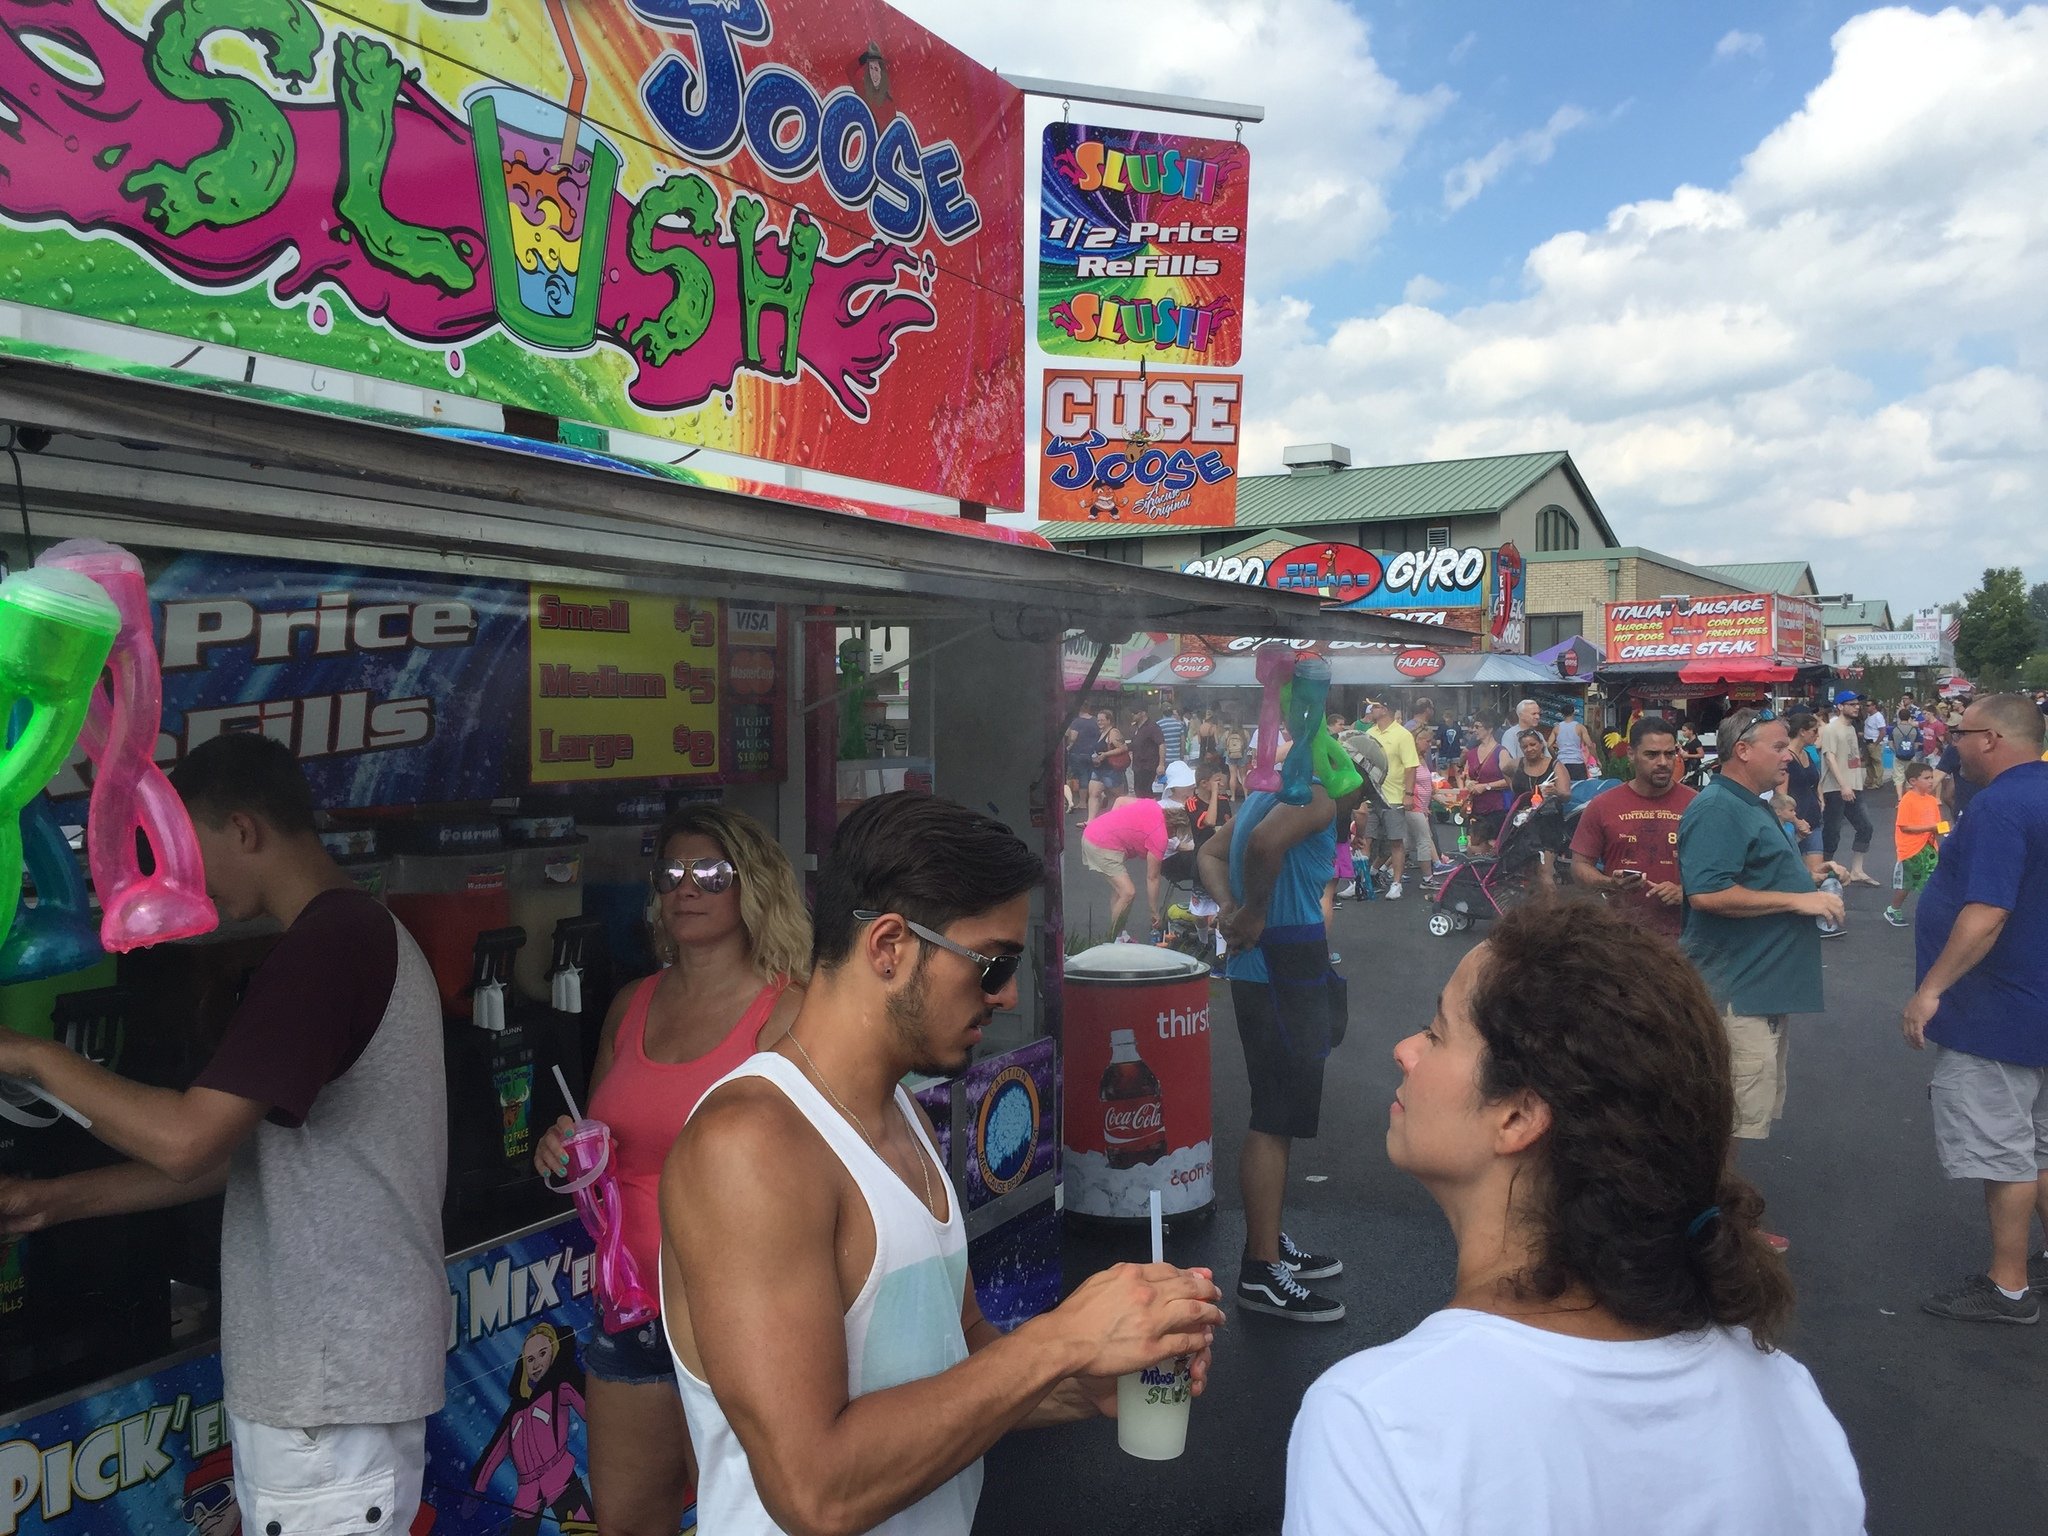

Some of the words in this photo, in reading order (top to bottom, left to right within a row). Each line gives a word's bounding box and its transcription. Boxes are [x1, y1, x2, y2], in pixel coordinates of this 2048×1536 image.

[1075, 141, 1219, 205] SLUSH
[1049, 217, 1117, 249] 1/2
[1128, 221, 1240, 244] Price
[1076, 254, 1221, 278] ReFills
[1070, 292, 1213, 352] SLUSH
[1045, 376, 1239, 445] CUSE
[1045, 430, 1234, 490] JOOSE
[1131, 488, 1181, 514] Syracuse
[1147, 492, 1191, 520] Original
[1385, 547, 1485, 592] GYRO
[160, 592, 477, 669] Price
[538, 594, 630, 633] Small
[673, 602, 715, 647] $3
[736, 611, 769, 631] VISA
[1615, 622, 1662, 632] BURGERS
[1707, 619, 1734, 627] CORN
[1737, 617, 1766, 625] DOGS
[1742, 627, 1769, 636] FRIES
[1613, 634, 1633, 642] HOT
[1636, 632, 1664, 641] DOGS
[1178, 656, 1206, 664] GYRO
[1620, 644, 1692, 659] CHEESE
[1695, 640, 1757, 655] STEAK
[731, 665, 775, 680] MasterCard
[1174, 664, 1210, 673] BOWLS
[1397, 657, 1440, 668] FALAFEL
[538, 663, 667, 699] Medium
[673, 660, 716, 704] $5
[735, 716, 771, 727] LIGHT
[745, 727, 762, 737] UP
[539, 728, 634, 769] Large
[673, 724, 715, 767] $8
[736, 738, 770, 749] MUGS
[1618, 812, 1655, 821] VINTAGE
[988, 1068, 1028, 1098] CAUTION
[1104, 1102, 1161, 1130] Coca-Cola
[986, 1175, 1007, 1193] CAUSE
[1007, 1168, 1026, 1191] BRAIN
